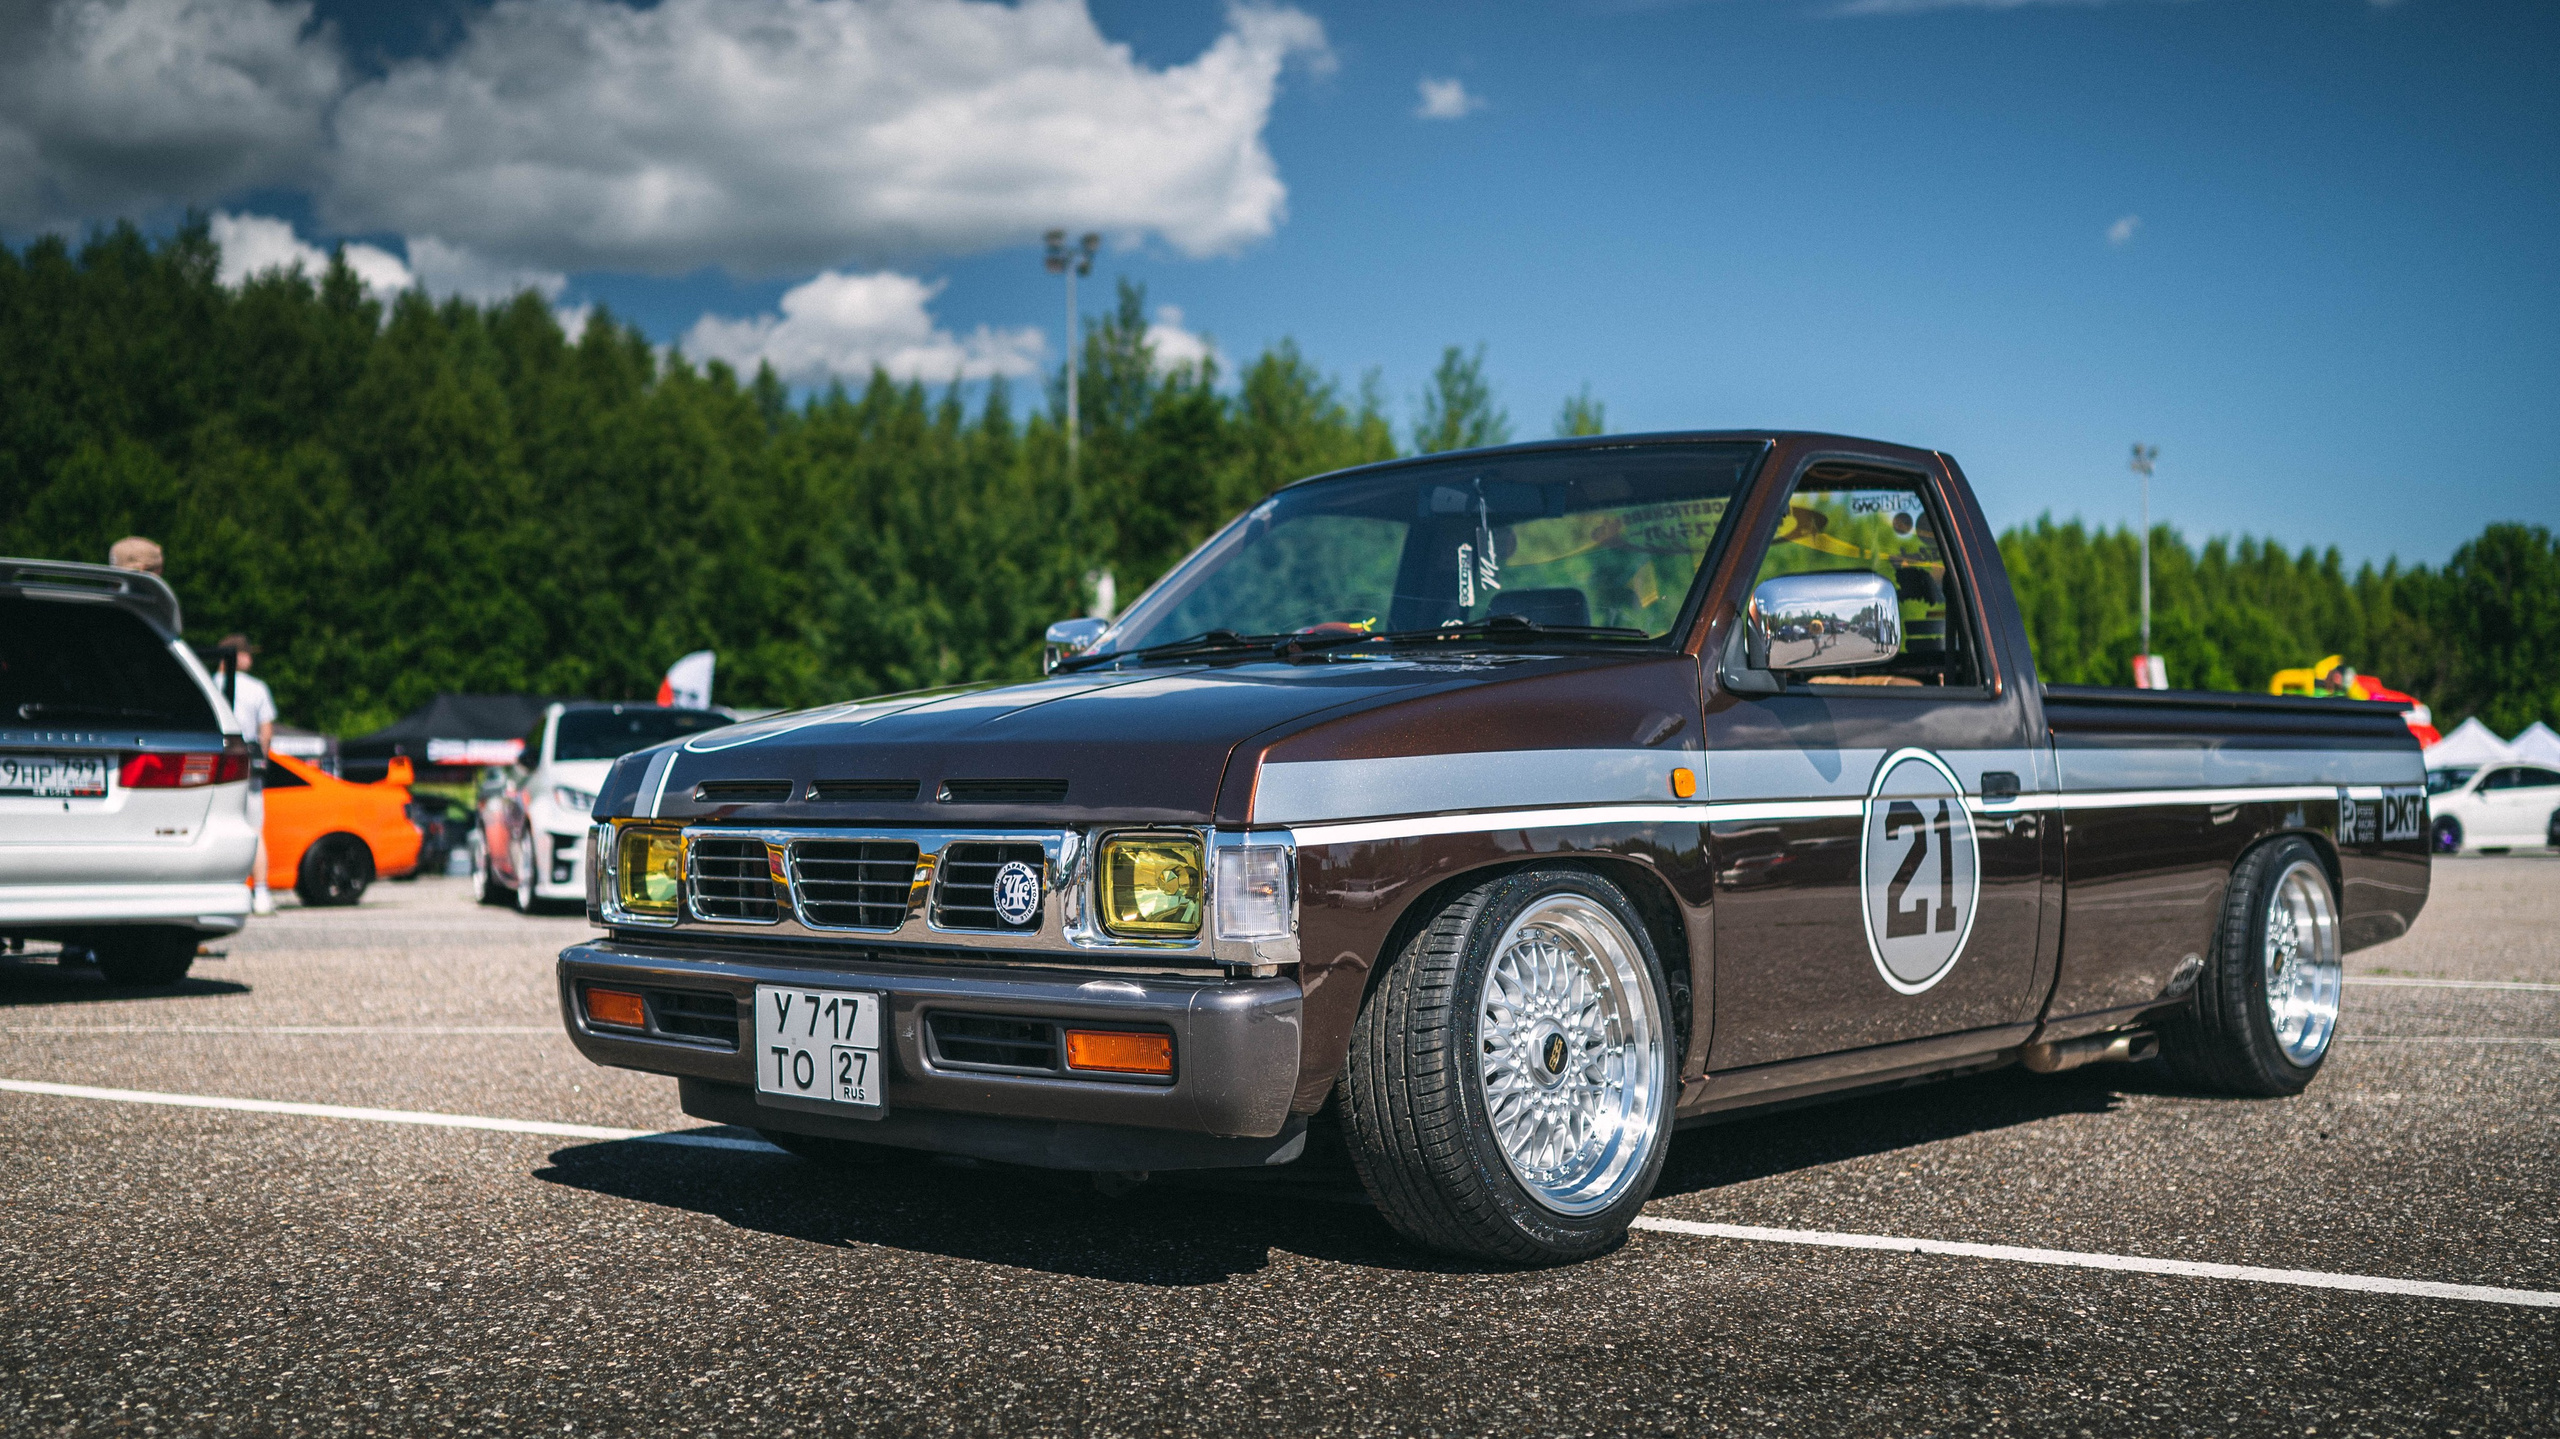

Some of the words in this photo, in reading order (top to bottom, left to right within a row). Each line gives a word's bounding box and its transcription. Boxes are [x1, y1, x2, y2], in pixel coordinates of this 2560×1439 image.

[2384, 790, 2421, 837] DKT
[1003, 863, 1026, 873] JAPAN
[1020, 877, 1037, 921] AUTOMOBILE
[1885, 800, 1957, 939] 21
[805, 995, 858, 1040] 717
[839, 1051, 867, 1085] 27
[1549, 1036, 1563, 1072] BBS
[844, 1087, 865, 1100] RUS
